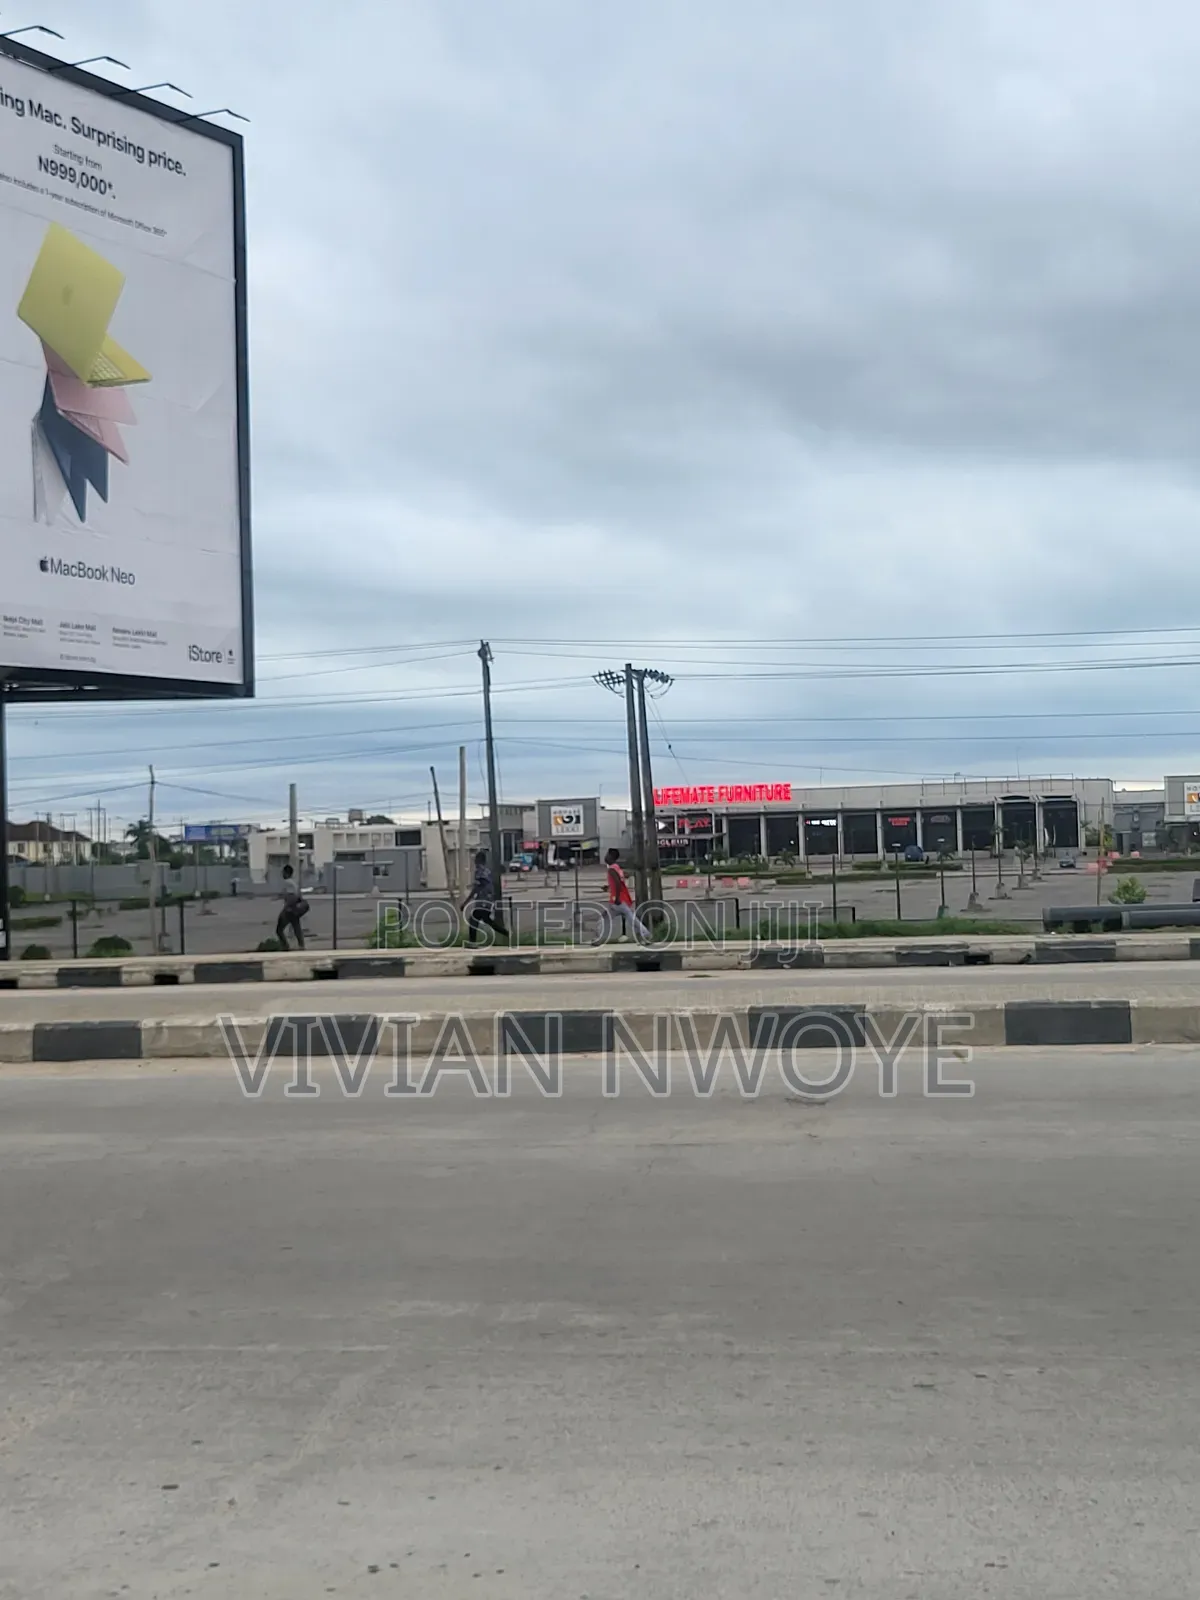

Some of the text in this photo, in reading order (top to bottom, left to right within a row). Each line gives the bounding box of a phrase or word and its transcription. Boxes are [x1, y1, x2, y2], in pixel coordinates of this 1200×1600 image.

[0, 87, 187, 176] ing Mac. Surprising price.
[53, 144, 103, 171] Starting from
[50, 557, 136, 586] MacBook Neo
[188, 645, 223, 664] iStore
[654, 783, 792, 806] LIFEMATE FURNITURE
[678, 816, 712, 829] PLAY
